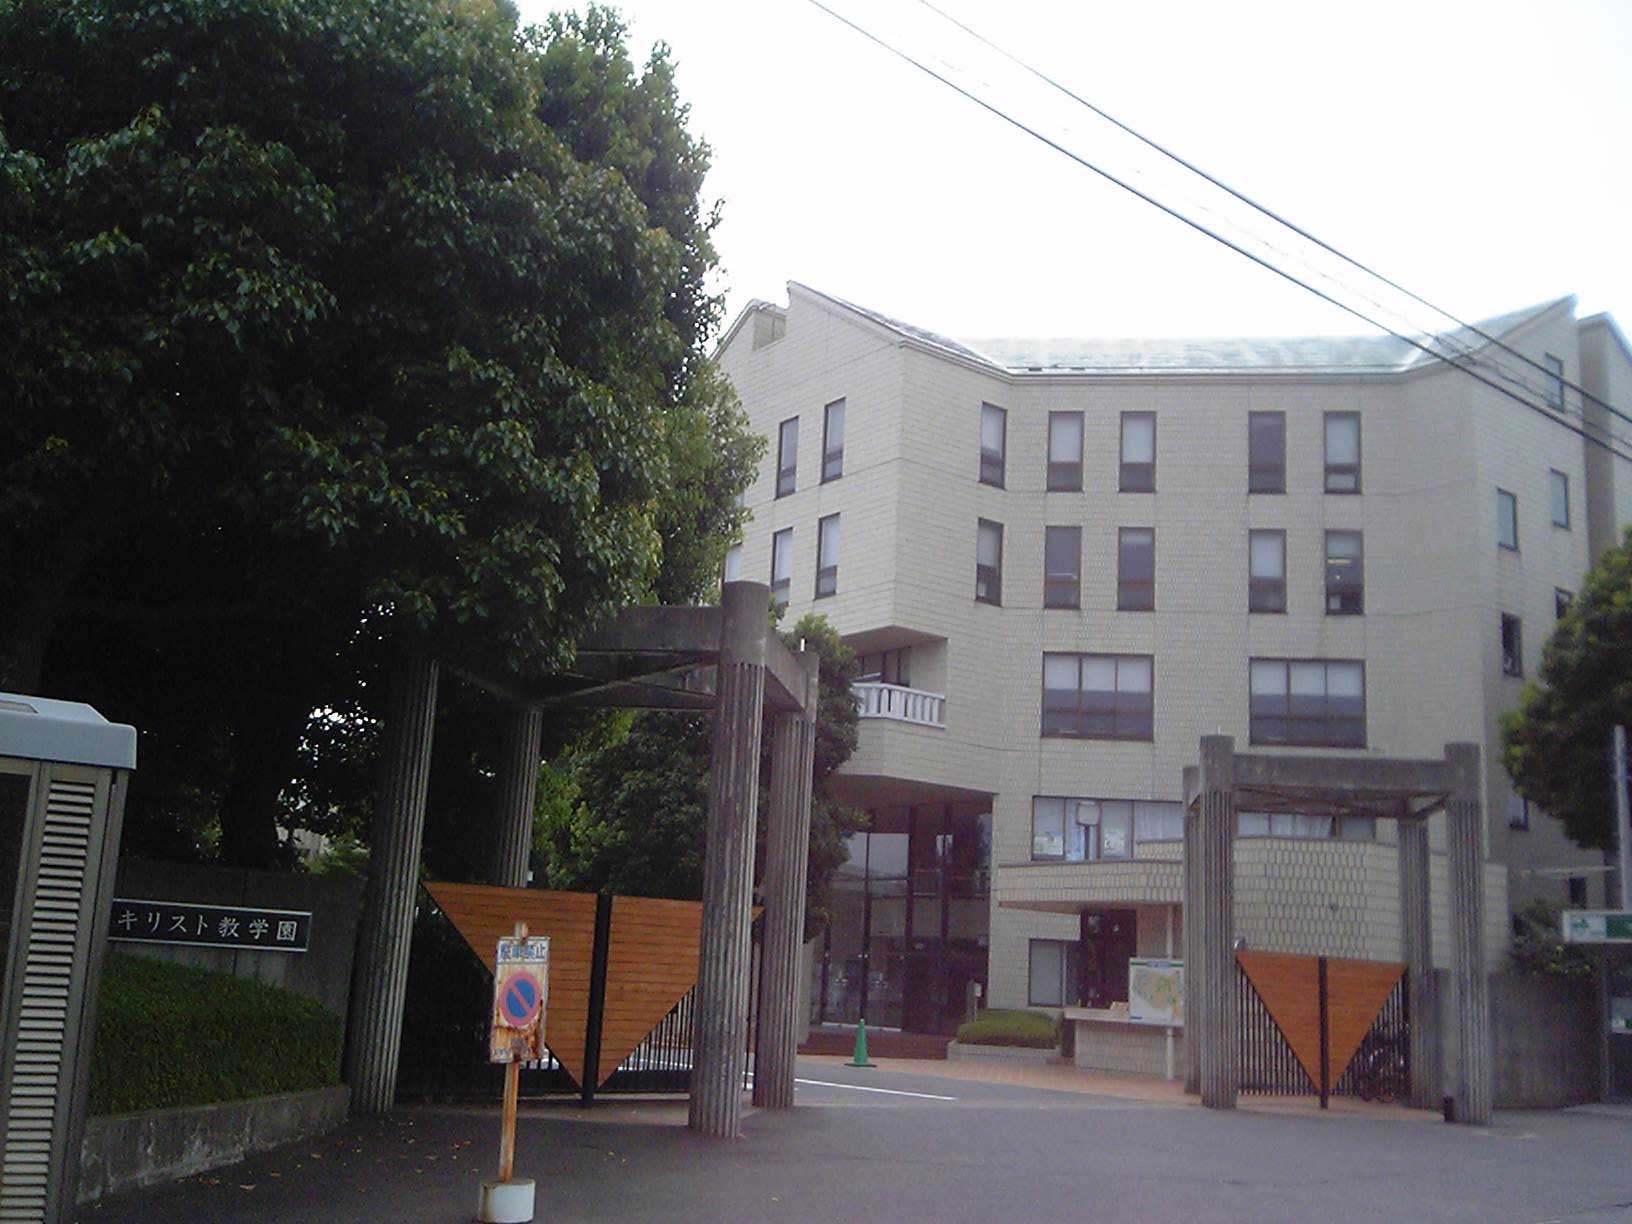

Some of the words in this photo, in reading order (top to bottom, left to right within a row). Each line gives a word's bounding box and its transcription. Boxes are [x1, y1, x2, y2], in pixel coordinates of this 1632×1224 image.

[118, 909, 298, 942] キリスト教学園
